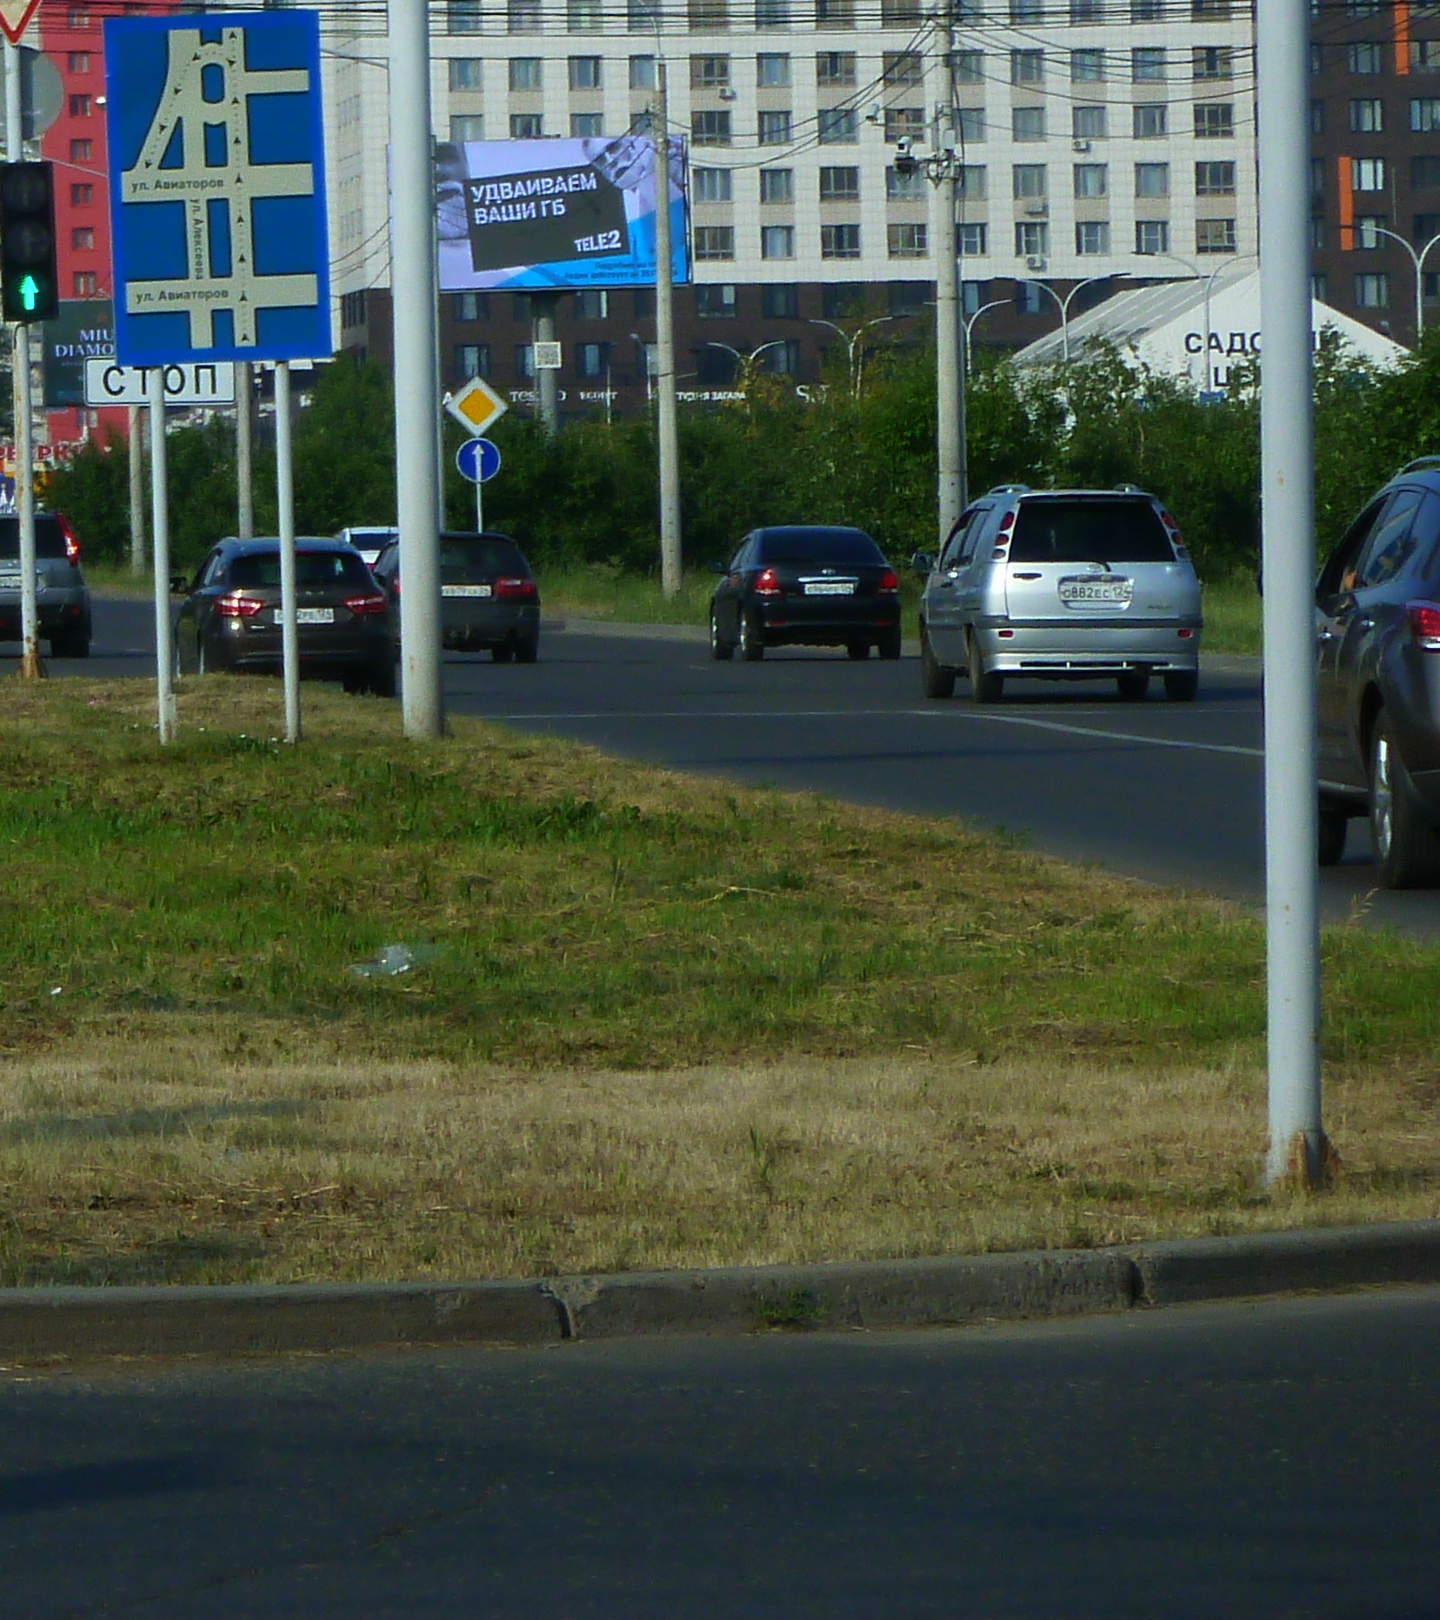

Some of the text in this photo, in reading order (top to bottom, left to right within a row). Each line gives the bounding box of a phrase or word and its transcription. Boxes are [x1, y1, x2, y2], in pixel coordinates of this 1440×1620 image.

[131, 178, 224, 194] ул. Авиаторов
[470, 171, 598, 205] УДВАИВАЕМ
[189, 198, 202, 216] ул.
[474, 198, 566, 225] ВАШИ ГБ
[573, 229, 622, 253] TELE2
[135, 289, 229, 304] ул. Авиаторов
[79, 329, 113, 342] MIU
[54, 343, 114, 357] DIAMO
[102, 365, 217, 396] СТОП
